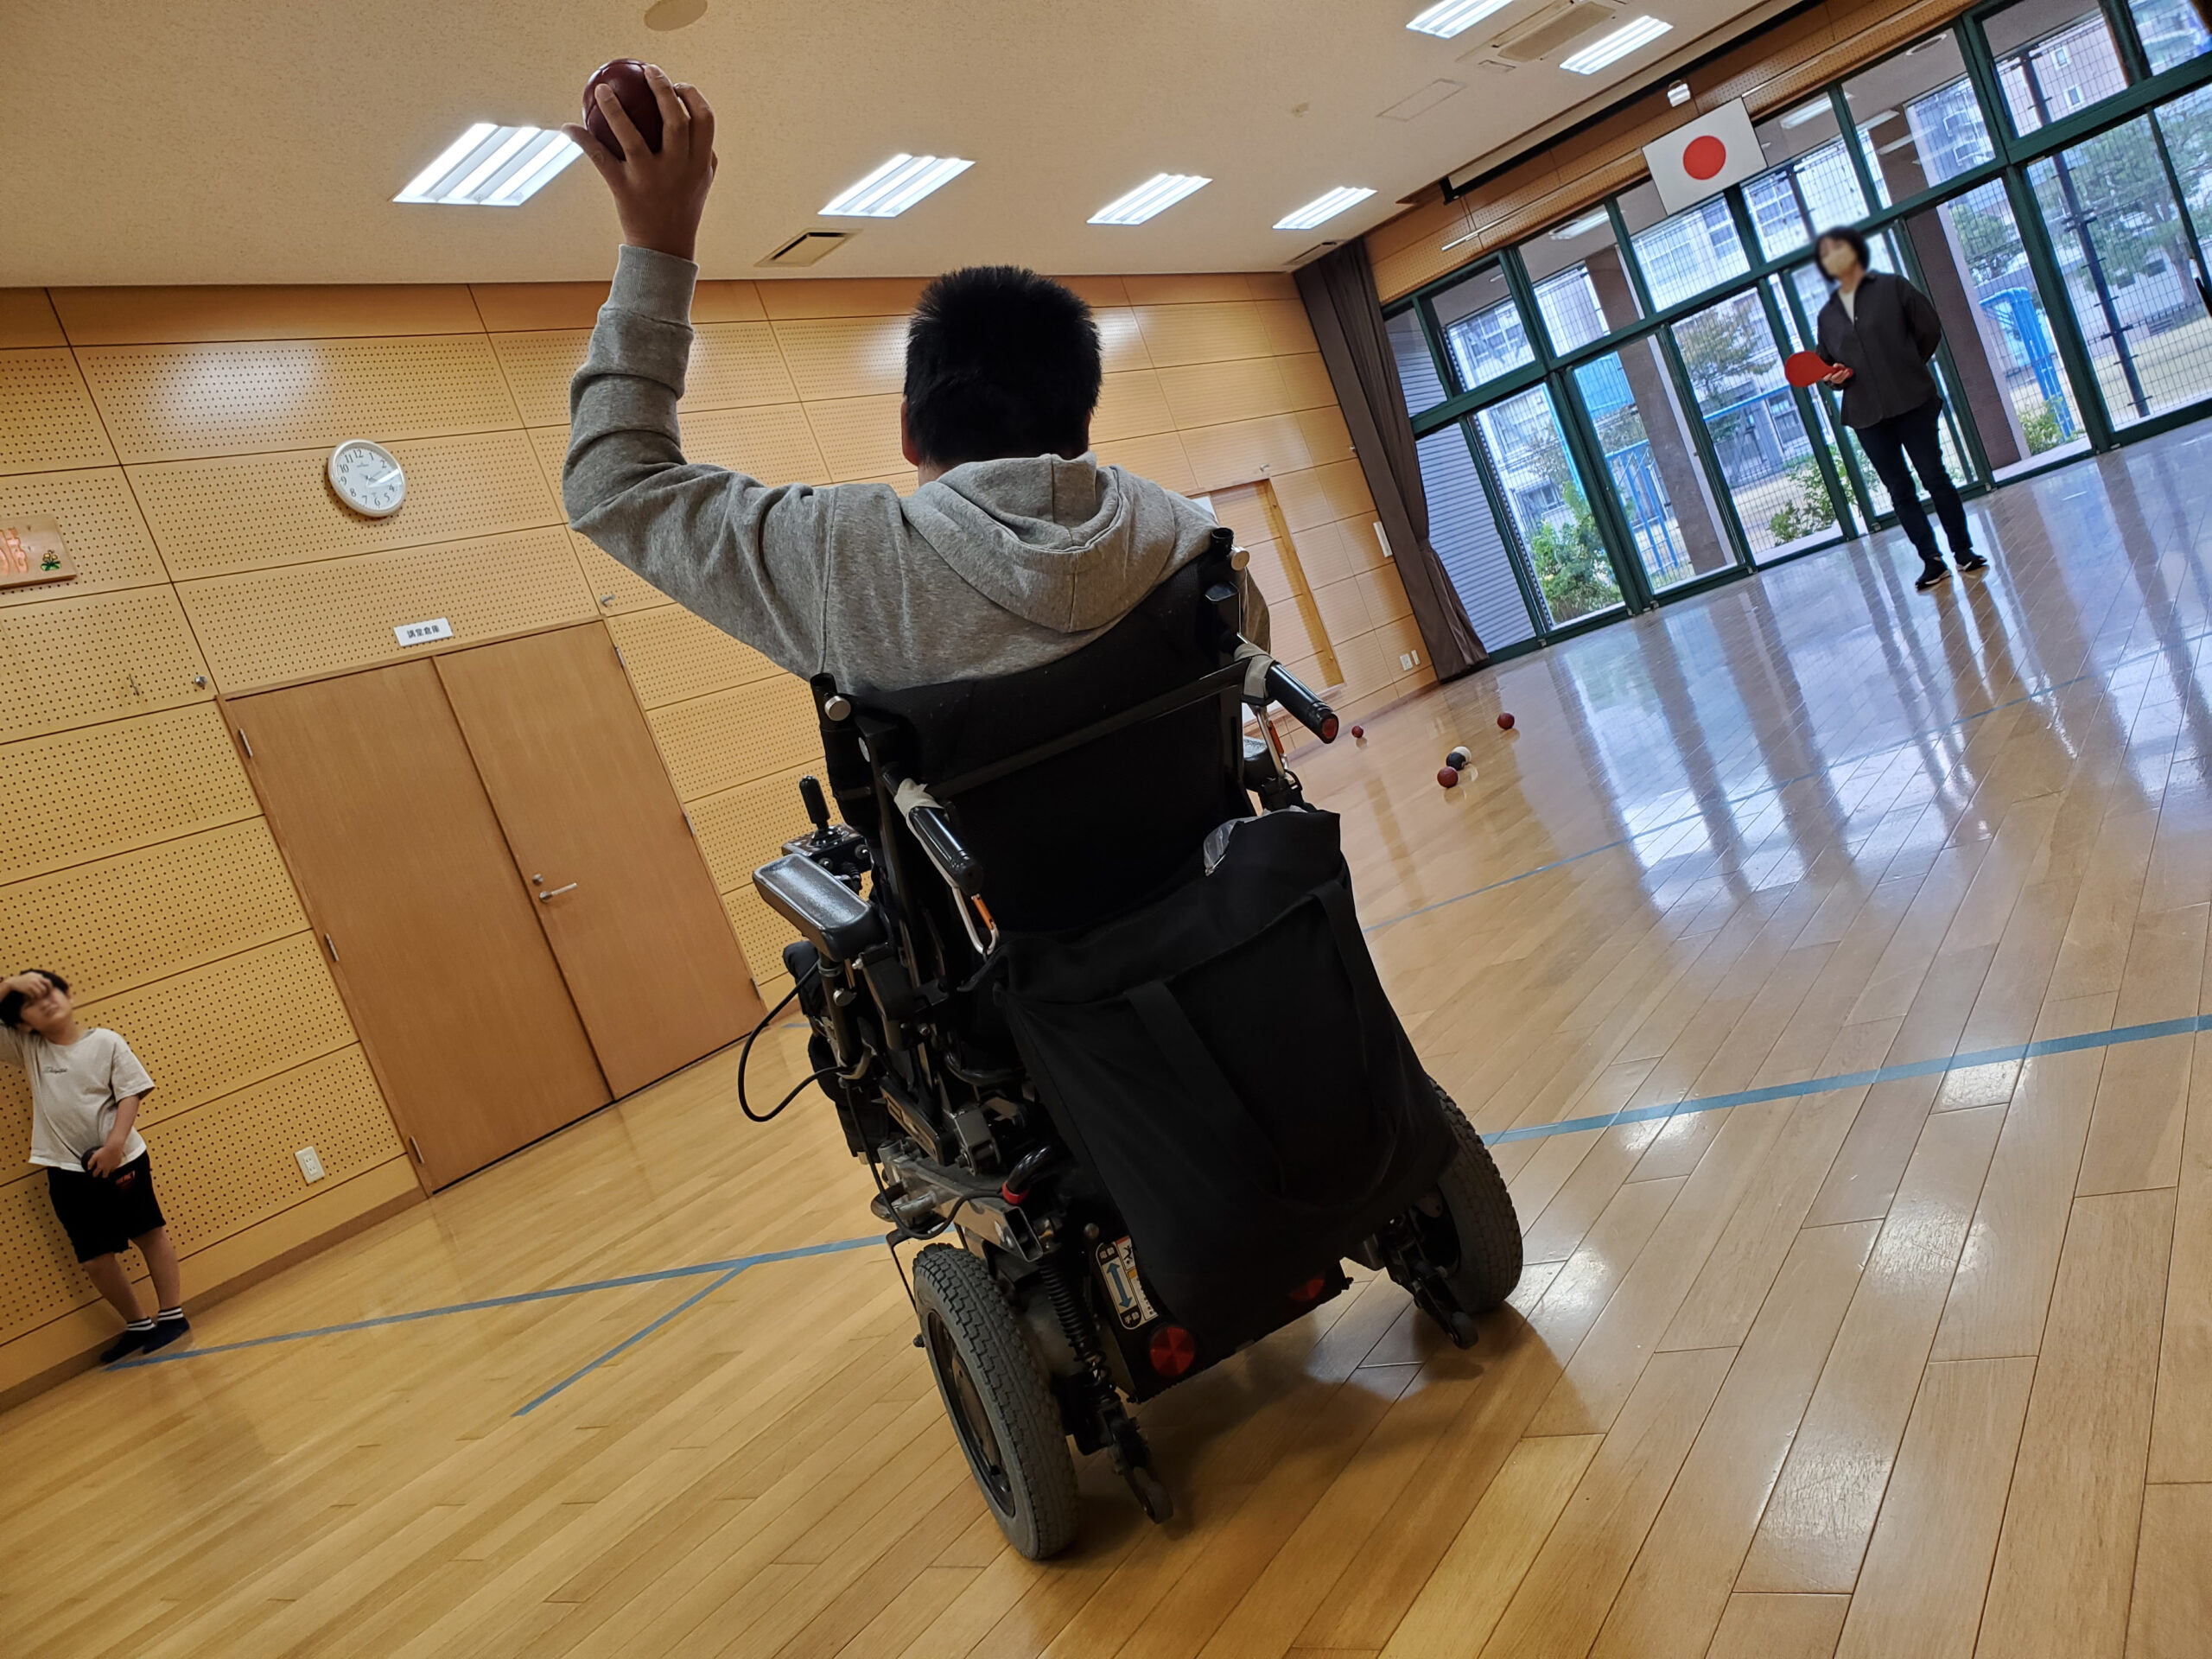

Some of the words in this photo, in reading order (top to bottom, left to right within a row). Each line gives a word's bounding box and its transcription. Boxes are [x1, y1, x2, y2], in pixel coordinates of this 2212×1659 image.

[353, 449, 364, 458] 12
[369, 452, 374, 461] 1
[345, 454, 353, 463] 11
[340, 464, 349, 474] 10
[380, 460, 387, 469] 2
[340, 476, 347, 486] 9
[350, 488, 357, 497] 8
[362, 496, 367, 505] 7
[374, 497, 381, 507] 6
[384, 493, 391, 502] 5
